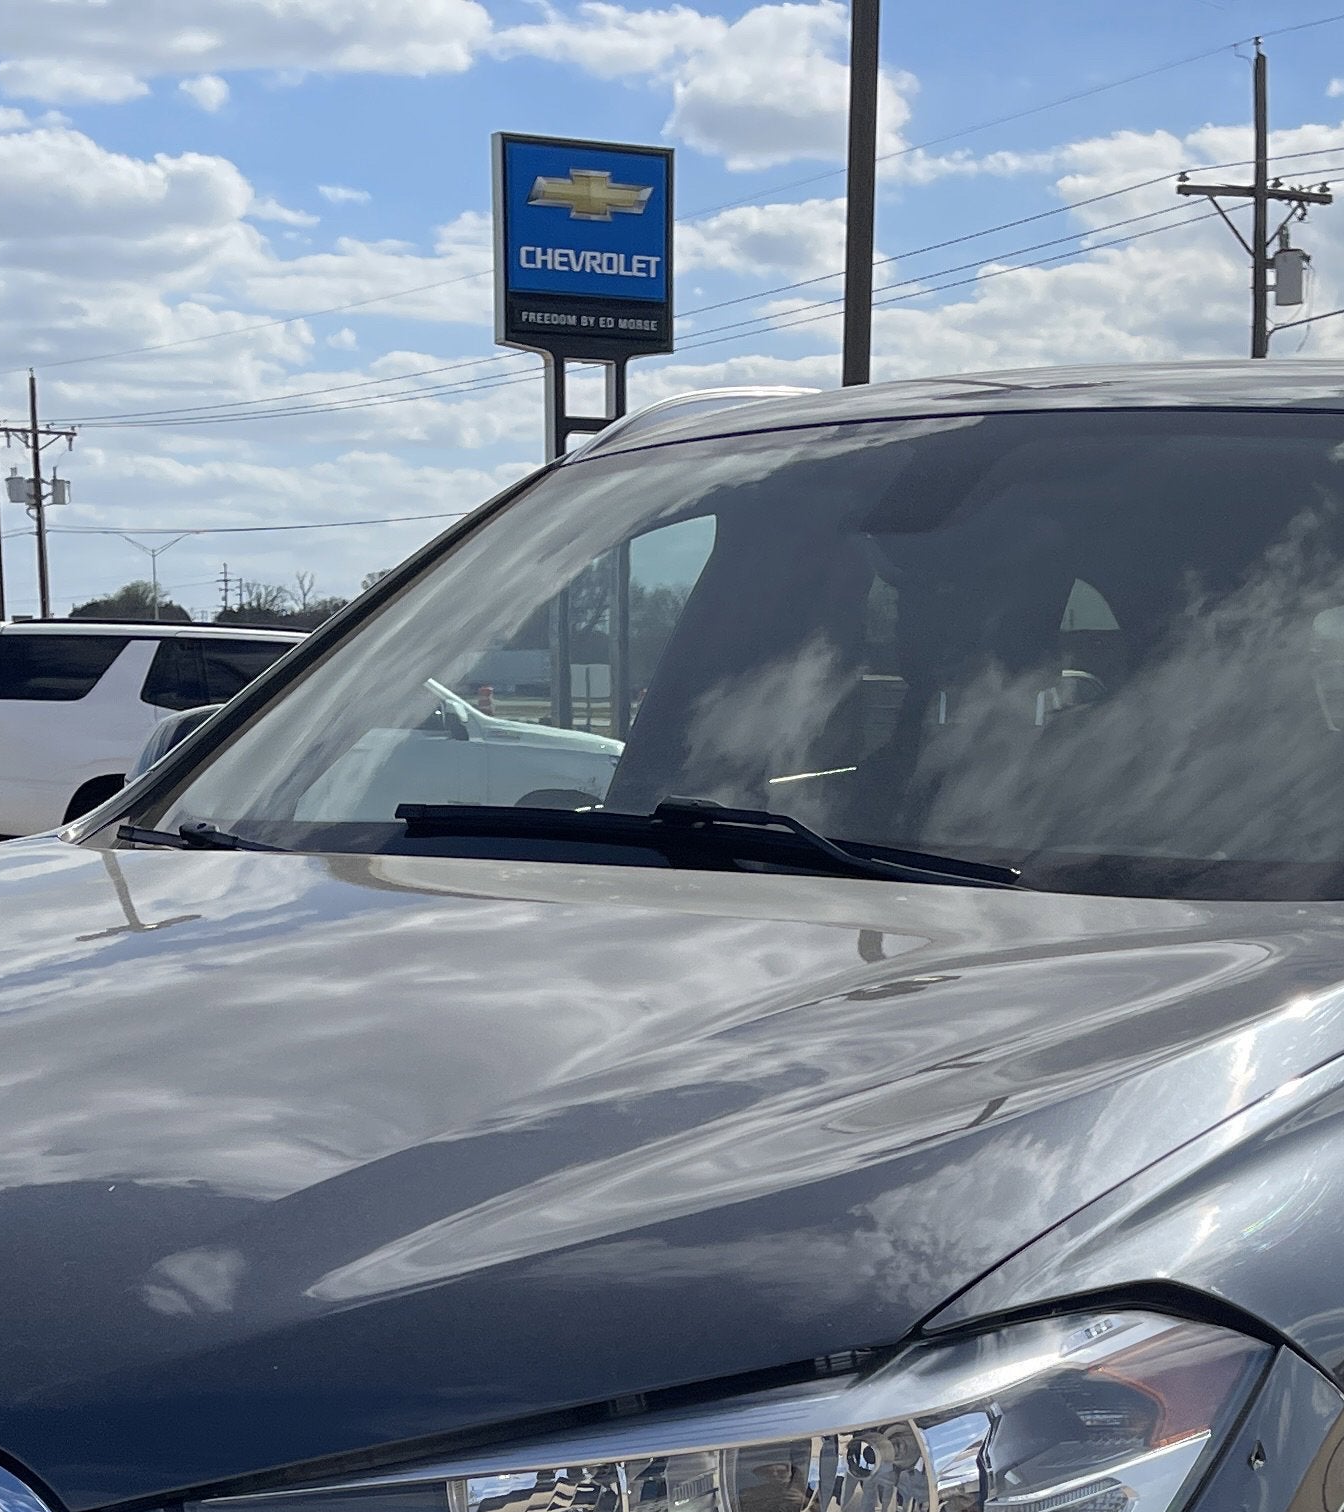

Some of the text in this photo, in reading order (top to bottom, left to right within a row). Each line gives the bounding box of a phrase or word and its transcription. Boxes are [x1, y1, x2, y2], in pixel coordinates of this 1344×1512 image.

[520, 246, 661, 278] CHEVROLET
[521, 311, 658, 331] FREEDOM BY ED MORSE
